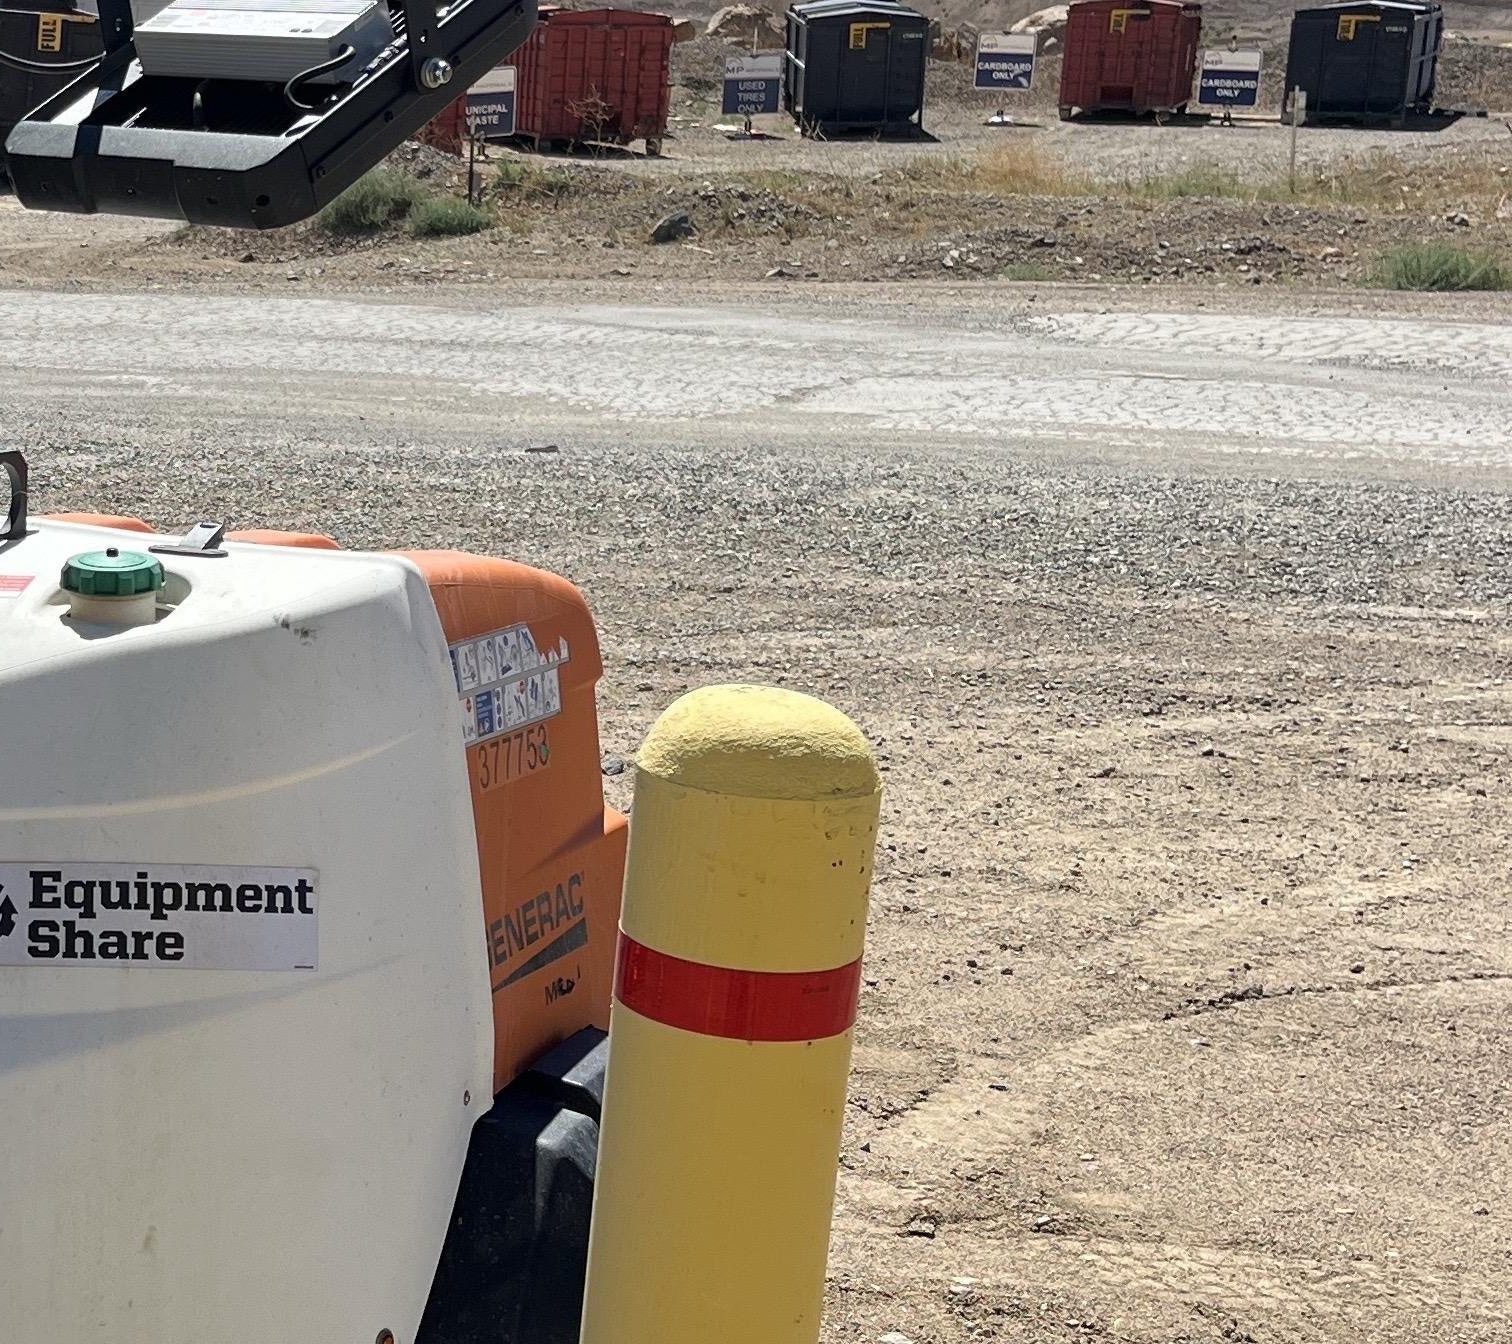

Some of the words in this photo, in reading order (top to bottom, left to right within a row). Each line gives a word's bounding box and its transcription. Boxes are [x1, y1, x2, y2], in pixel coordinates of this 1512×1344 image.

[40, 19, 58, 51] FULL
[978, 62, 1032, 72] CARDBOARD
[992, 71, 1015, 80] ONLY
[738, 80, 766, 91] USED
[1201, 78, 1257, 89] CARDBOARD
[737, 92, 766, 102] TIRES
[1216, 88, 1240, 98] ONLY
[465, 104, 509, 116] UNICIPAL
[737, 103, 764, 114] ONLY
[28, 869, 314, 920] Equipment
[487, 871, 585, 970] ENERAC
[27, 919, 185, 961] Share
